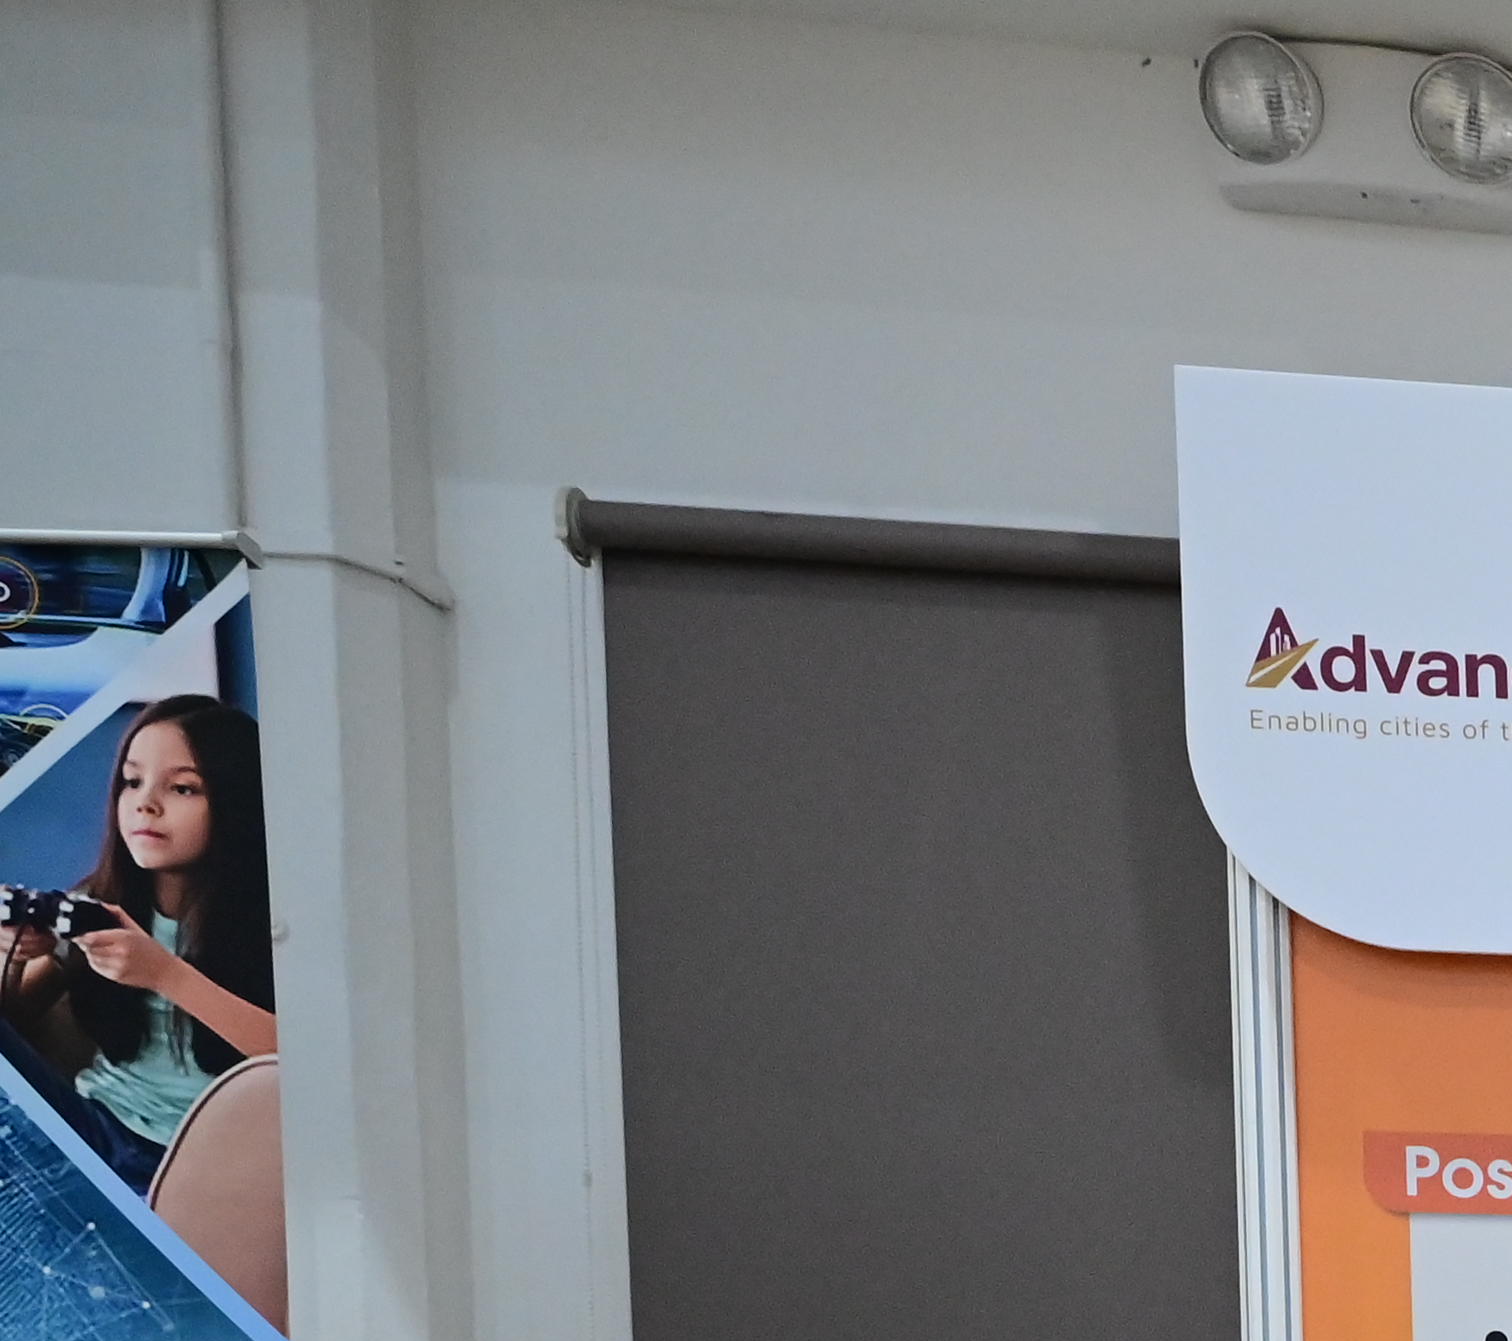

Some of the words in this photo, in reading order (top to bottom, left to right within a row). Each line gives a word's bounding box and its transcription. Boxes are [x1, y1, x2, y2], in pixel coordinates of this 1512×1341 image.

[1250, 709, 1368, 739] Enabling
[1379, 716, 1451, 738] cities
[1462, 719, 1489, 740] of
